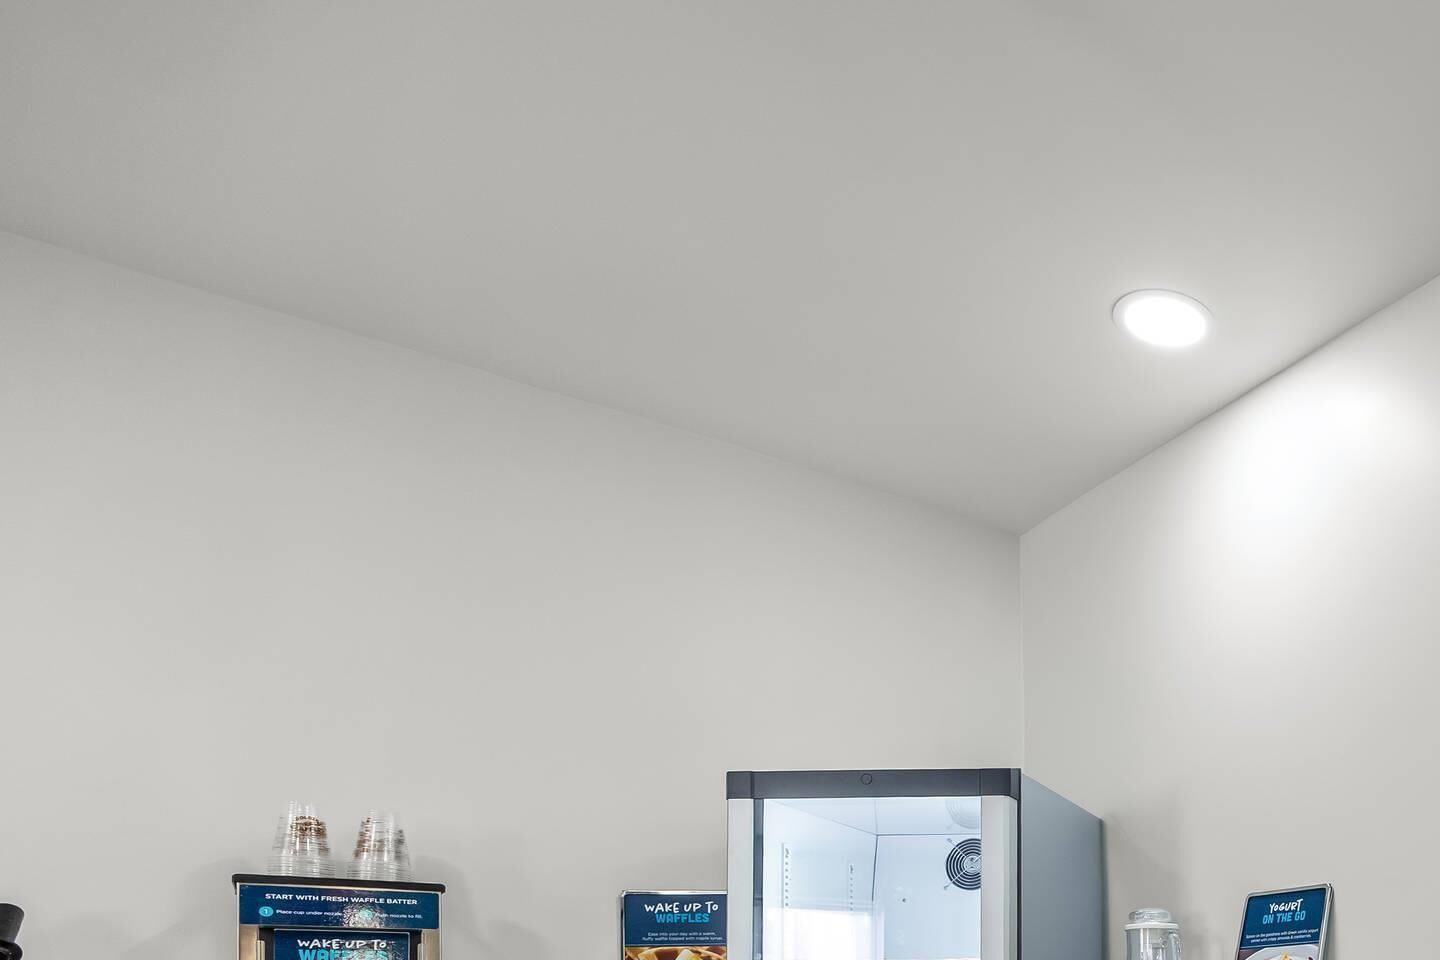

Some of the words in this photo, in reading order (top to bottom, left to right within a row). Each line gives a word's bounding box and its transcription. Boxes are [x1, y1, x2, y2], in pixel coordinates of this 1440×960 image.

[265, 893, 294, 901] START
[296, 894, 319, 902] WITH
[321, 895, 349, 903] FRESH
[644, 902, 680, 914] WAKE
[684, 902, 702, 912] UP
[655, 912, 710, 924] WAFFLES
[1262, 914, 1275, 925] ON
[1276, 912, 1293, 923] THE
[1294, 910, 1306, 921] GO
[297, 938, 341, 950] WAKE
[345, 940, 367, 949] UP
